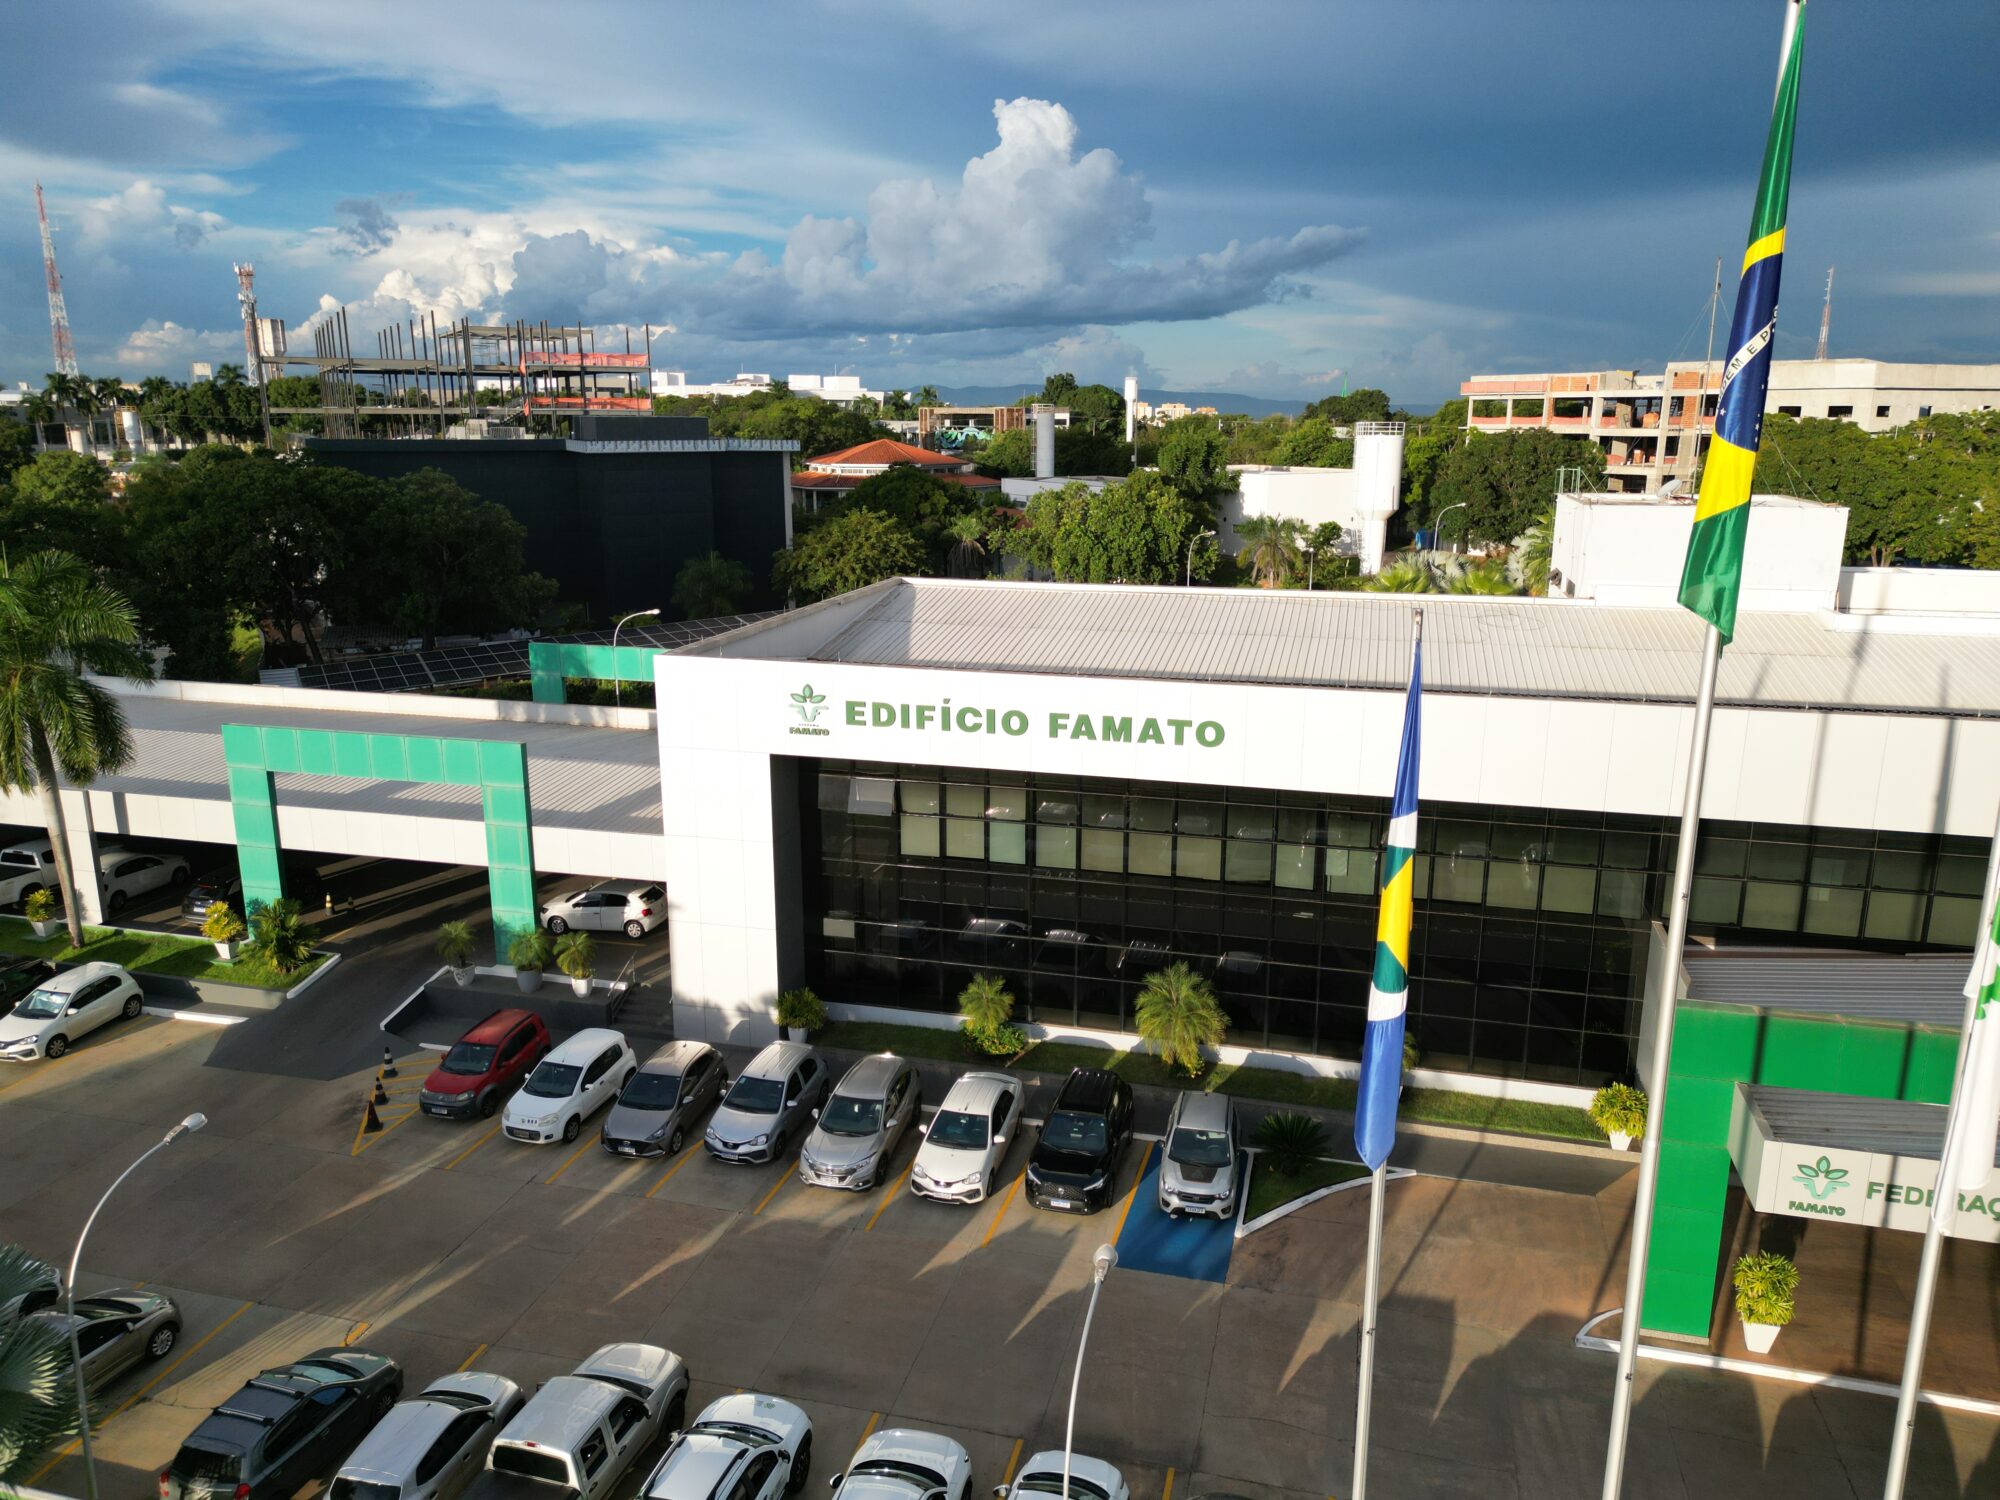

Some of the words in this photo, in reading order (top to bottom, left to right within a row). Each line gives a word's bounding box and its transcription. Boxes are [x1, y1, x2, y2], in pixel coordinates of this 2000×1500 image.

[789, 727, 830, 736] FAMATO
[845, 698, 1029, 737] EDIFÍCIO
[1048, 712, 1226, 748] FAMATO
[1788, 1200, 1846, 1217] FAMATO
